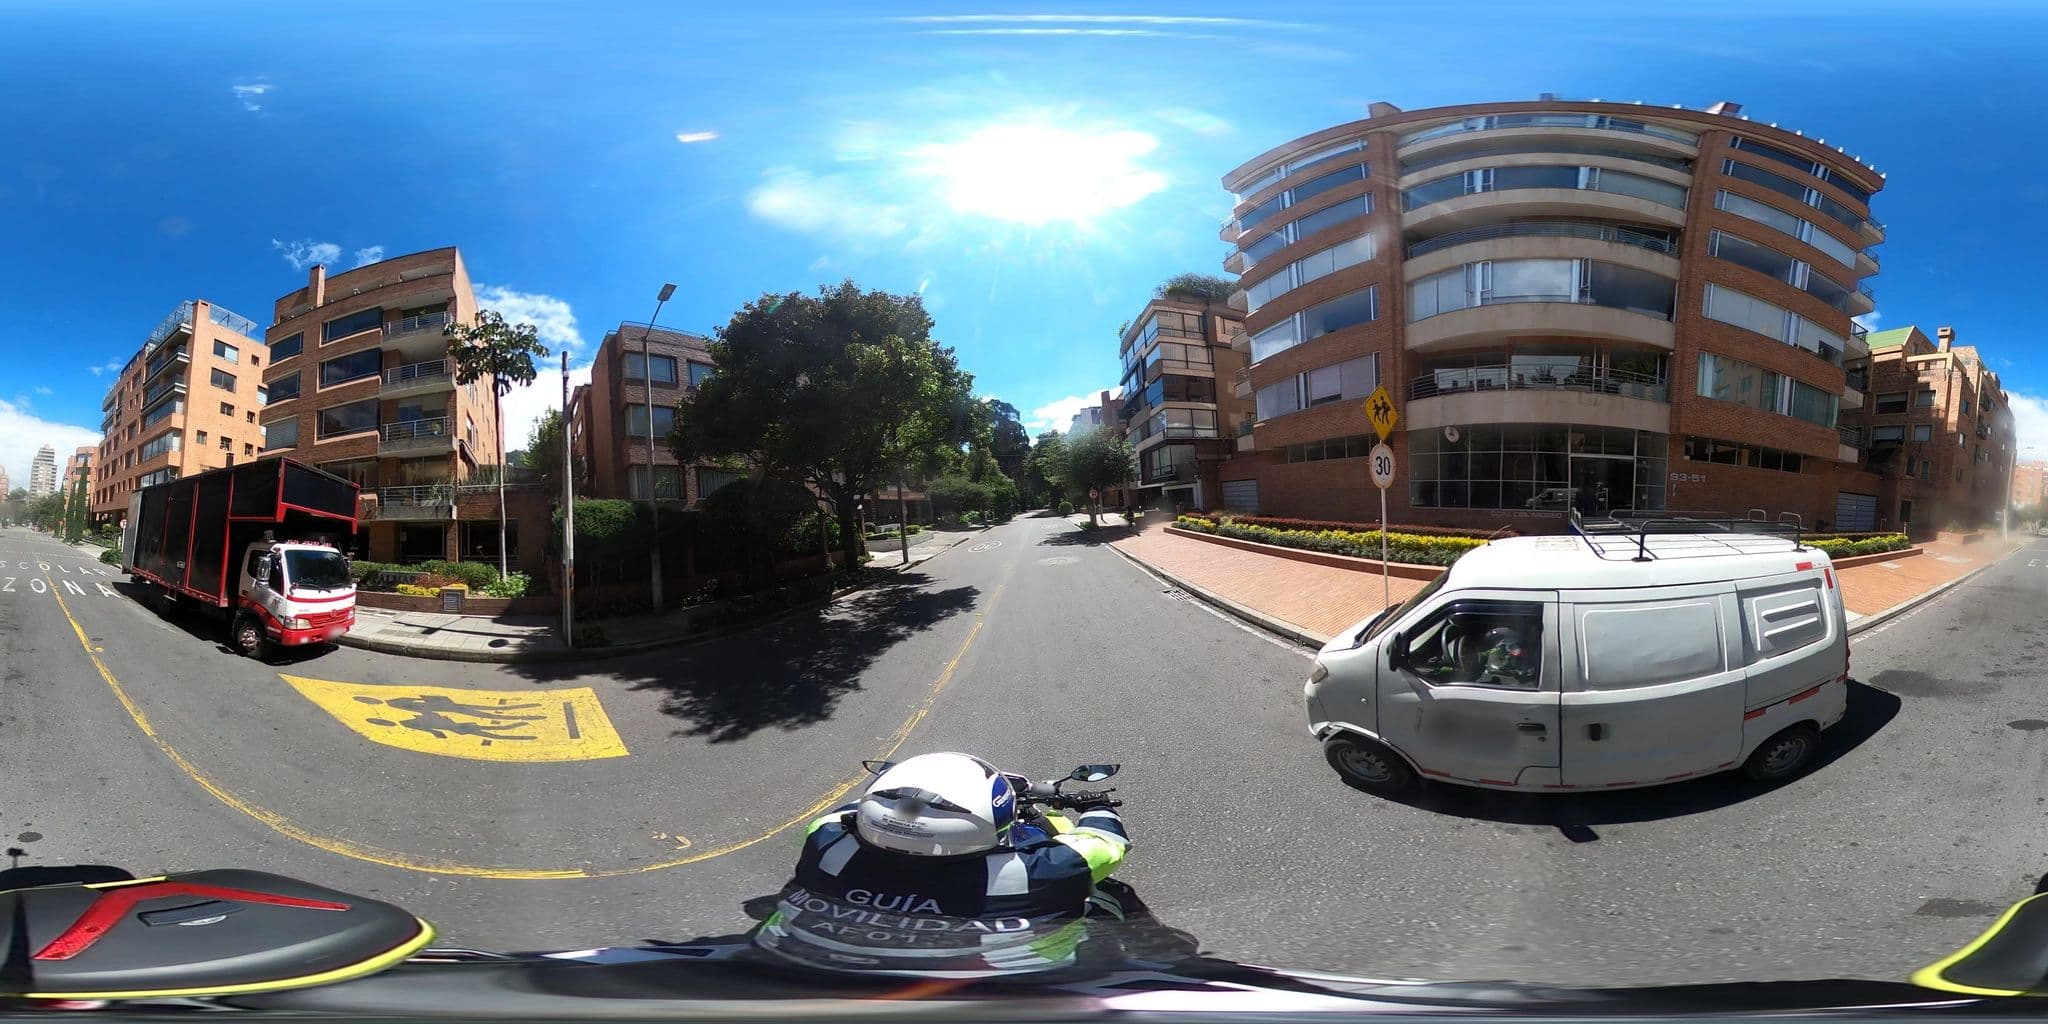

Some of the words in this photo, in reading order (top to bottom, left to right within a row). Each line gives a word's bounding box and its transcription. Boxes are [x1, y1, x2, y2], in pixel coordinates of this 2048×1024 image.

[1376, 456, 1391, 476] 30
[2, 576, 122, 599] ZONA
[787, 888, 1031, 933] MOVILIDAD
[845, 888, 942, 915] GUÍA
